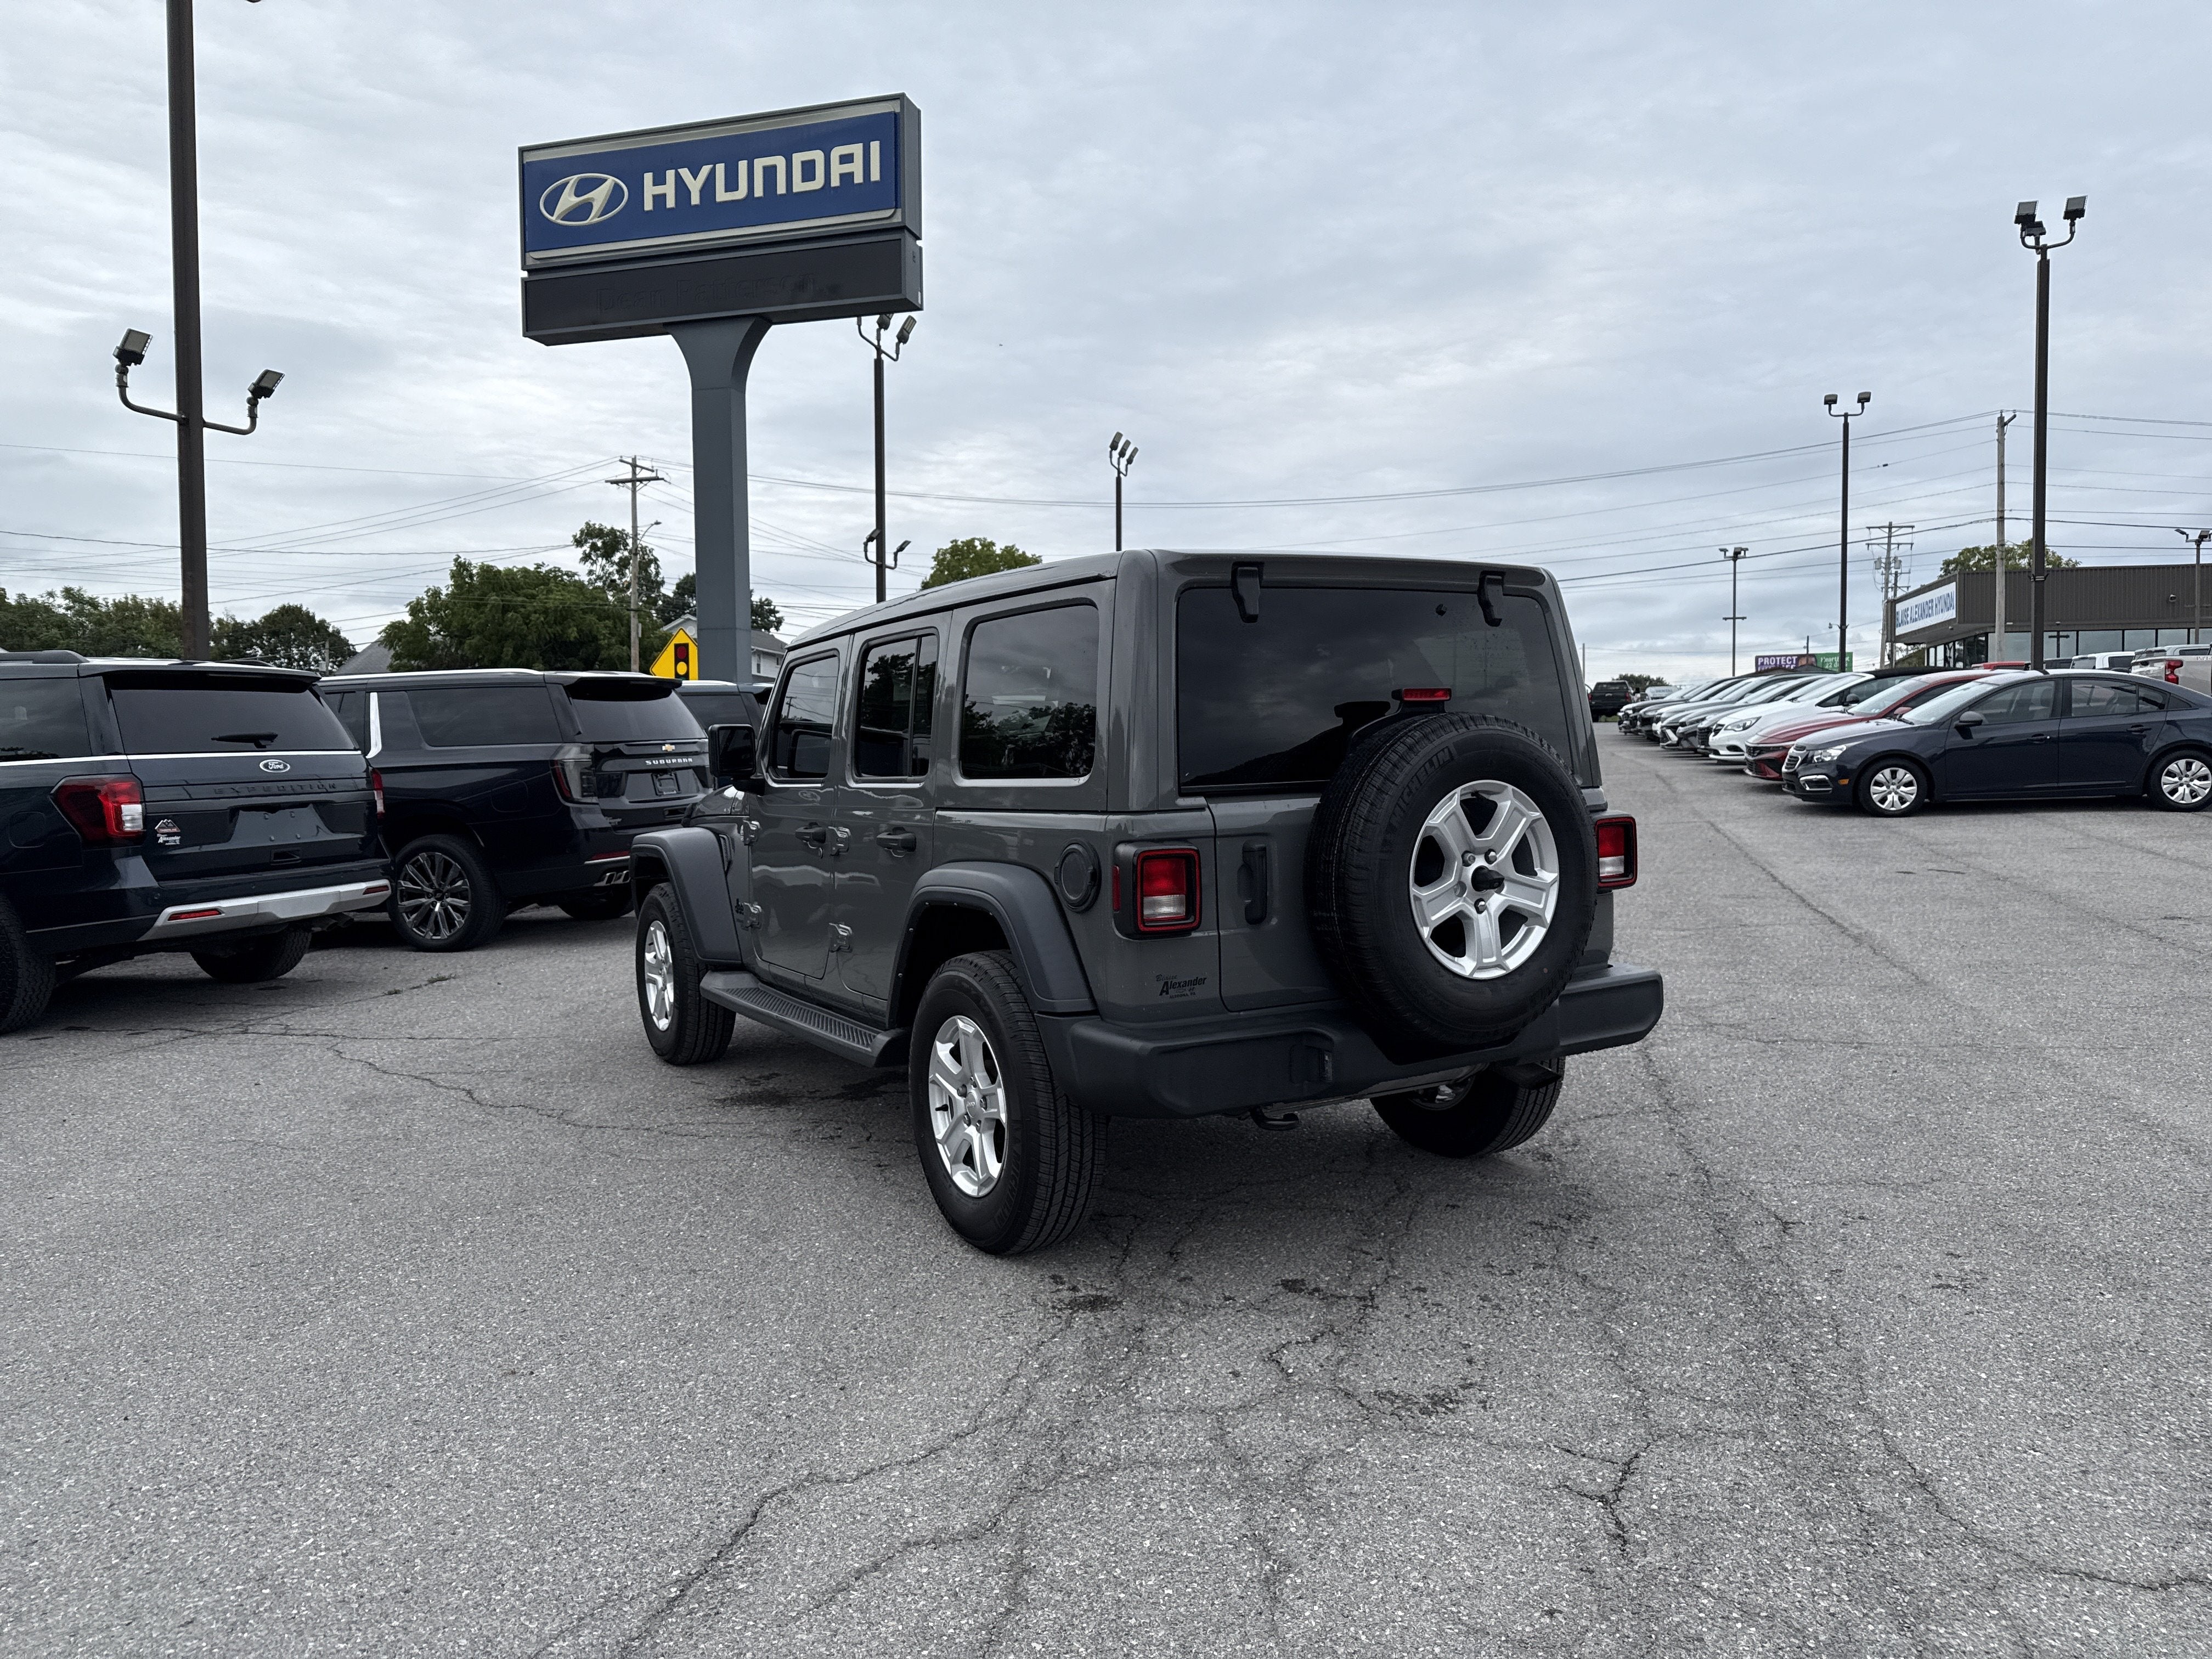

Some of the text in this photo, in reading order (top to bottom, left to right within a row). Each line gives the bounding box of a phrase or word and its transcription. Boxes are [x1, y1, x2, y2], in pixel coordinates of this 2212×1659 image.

[644, 140, 881, 212] HYUNDAI
[1896, 591, 1954, 628] BLAISE ALEXANDER HYUNDAI
[1758, 656, 1798, 665] PROTECT
[268, 761, 284, 770] Ford
[213, 782, 337, 794] EXPEDITION
[1159, 977, 1207, 996] Alexander
